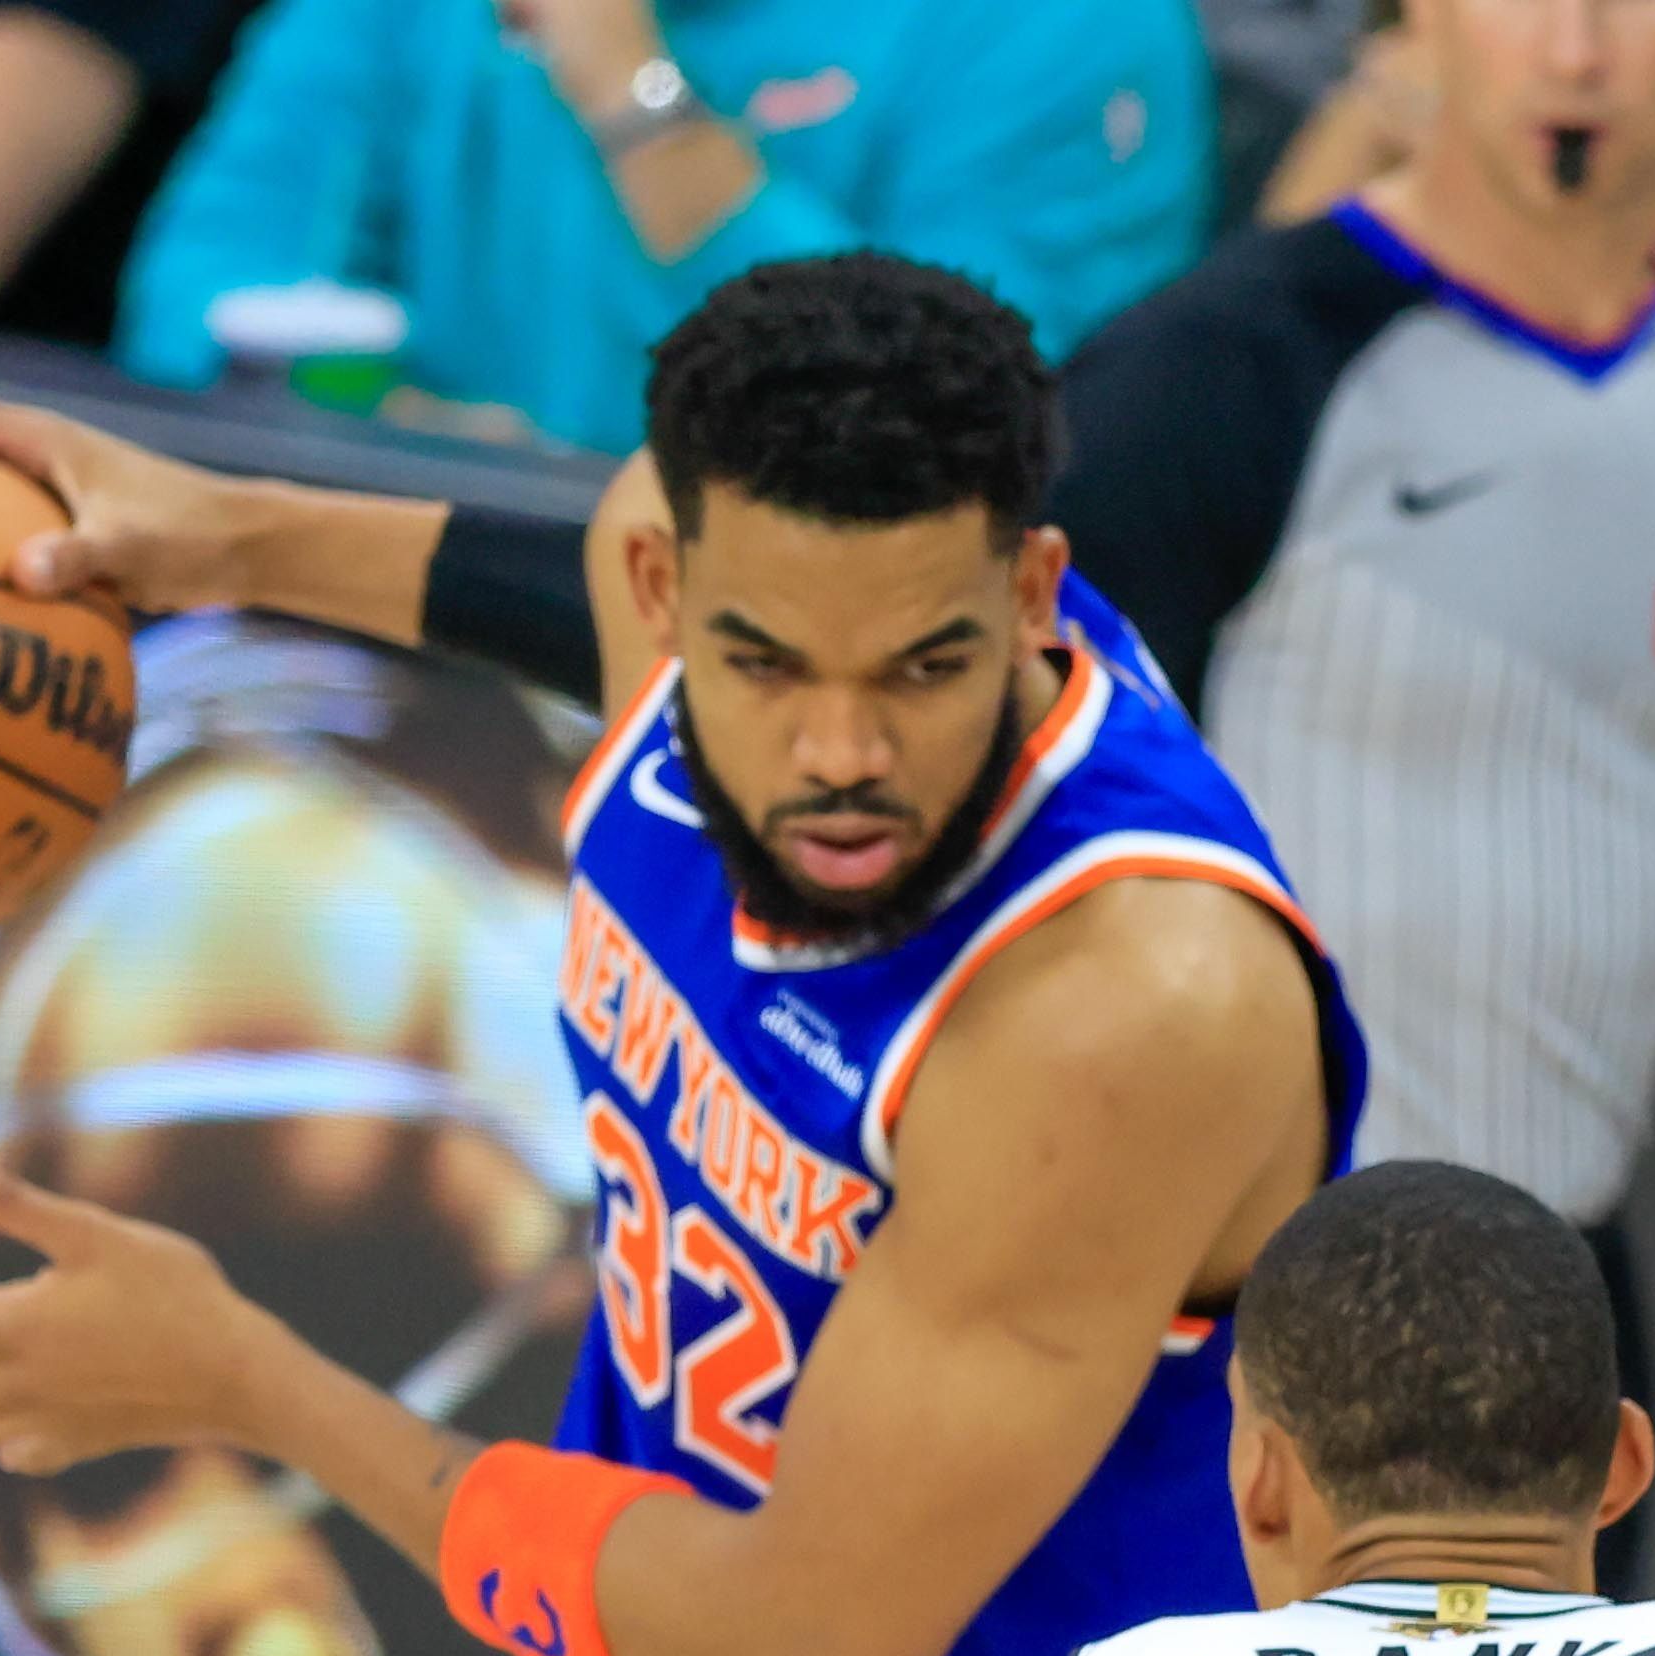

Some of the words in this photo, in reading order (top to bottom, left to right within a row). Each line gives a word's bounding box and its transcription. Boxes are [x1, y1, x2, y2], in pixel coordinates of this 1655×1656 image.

[559, 872, 683, 1106] NEW
[668, 1018, 883, 1282] YORK
[585, 1089, 797, 1497] 32
